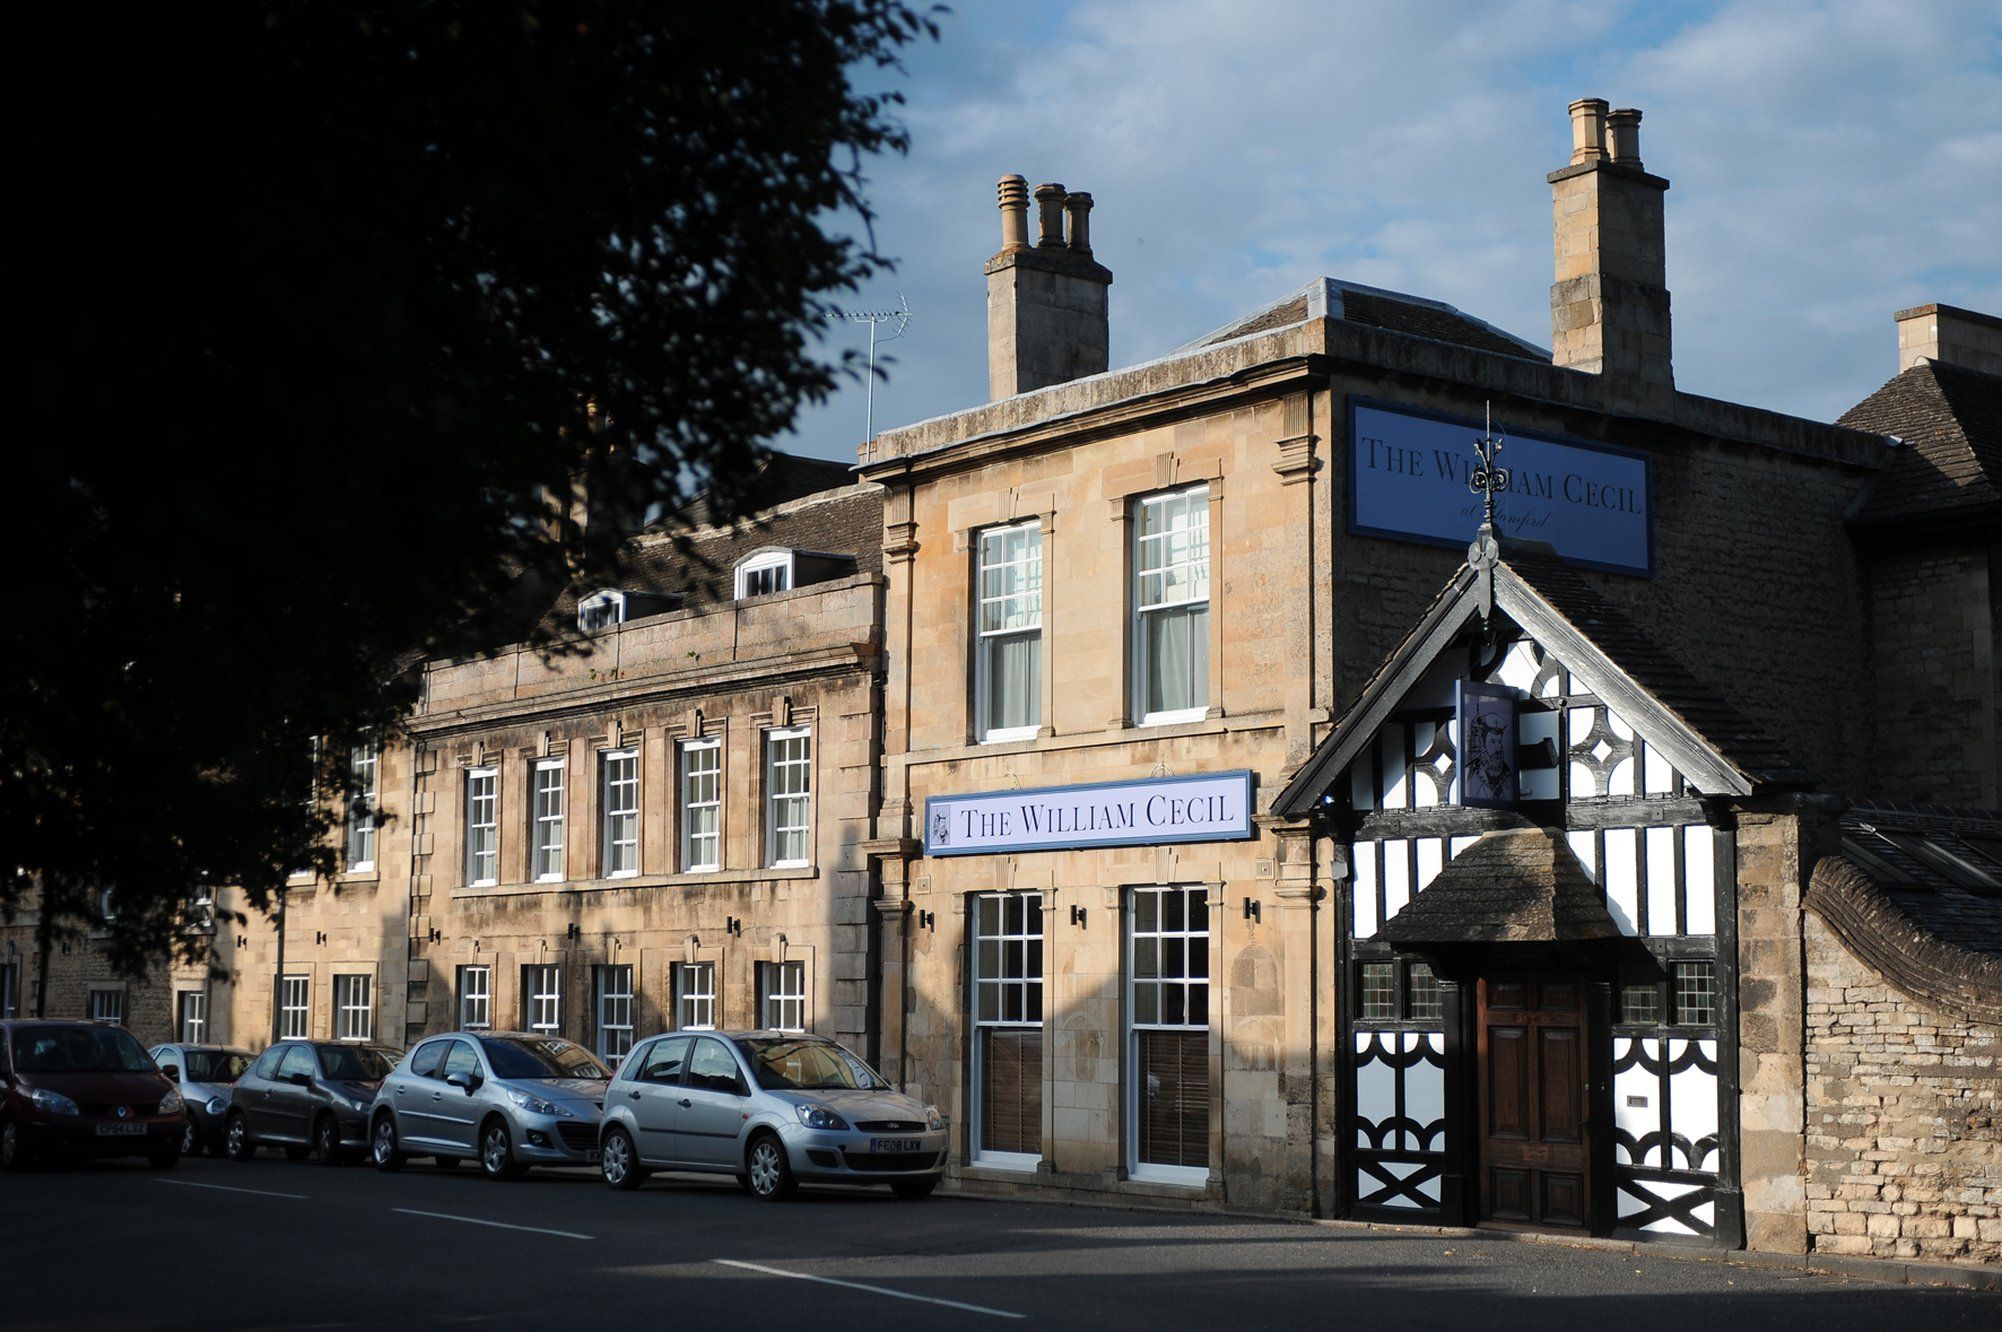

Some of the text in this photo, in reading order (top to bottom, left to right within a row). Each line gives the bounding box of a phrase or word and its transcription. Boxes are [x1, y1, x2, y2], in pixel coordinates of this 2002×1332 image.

[1361, 436, 1424, 477] THE
[1563, 473, 1642, 514] CECIL
[961, 795, 1235, 837] THE WILLIAM CECIL
